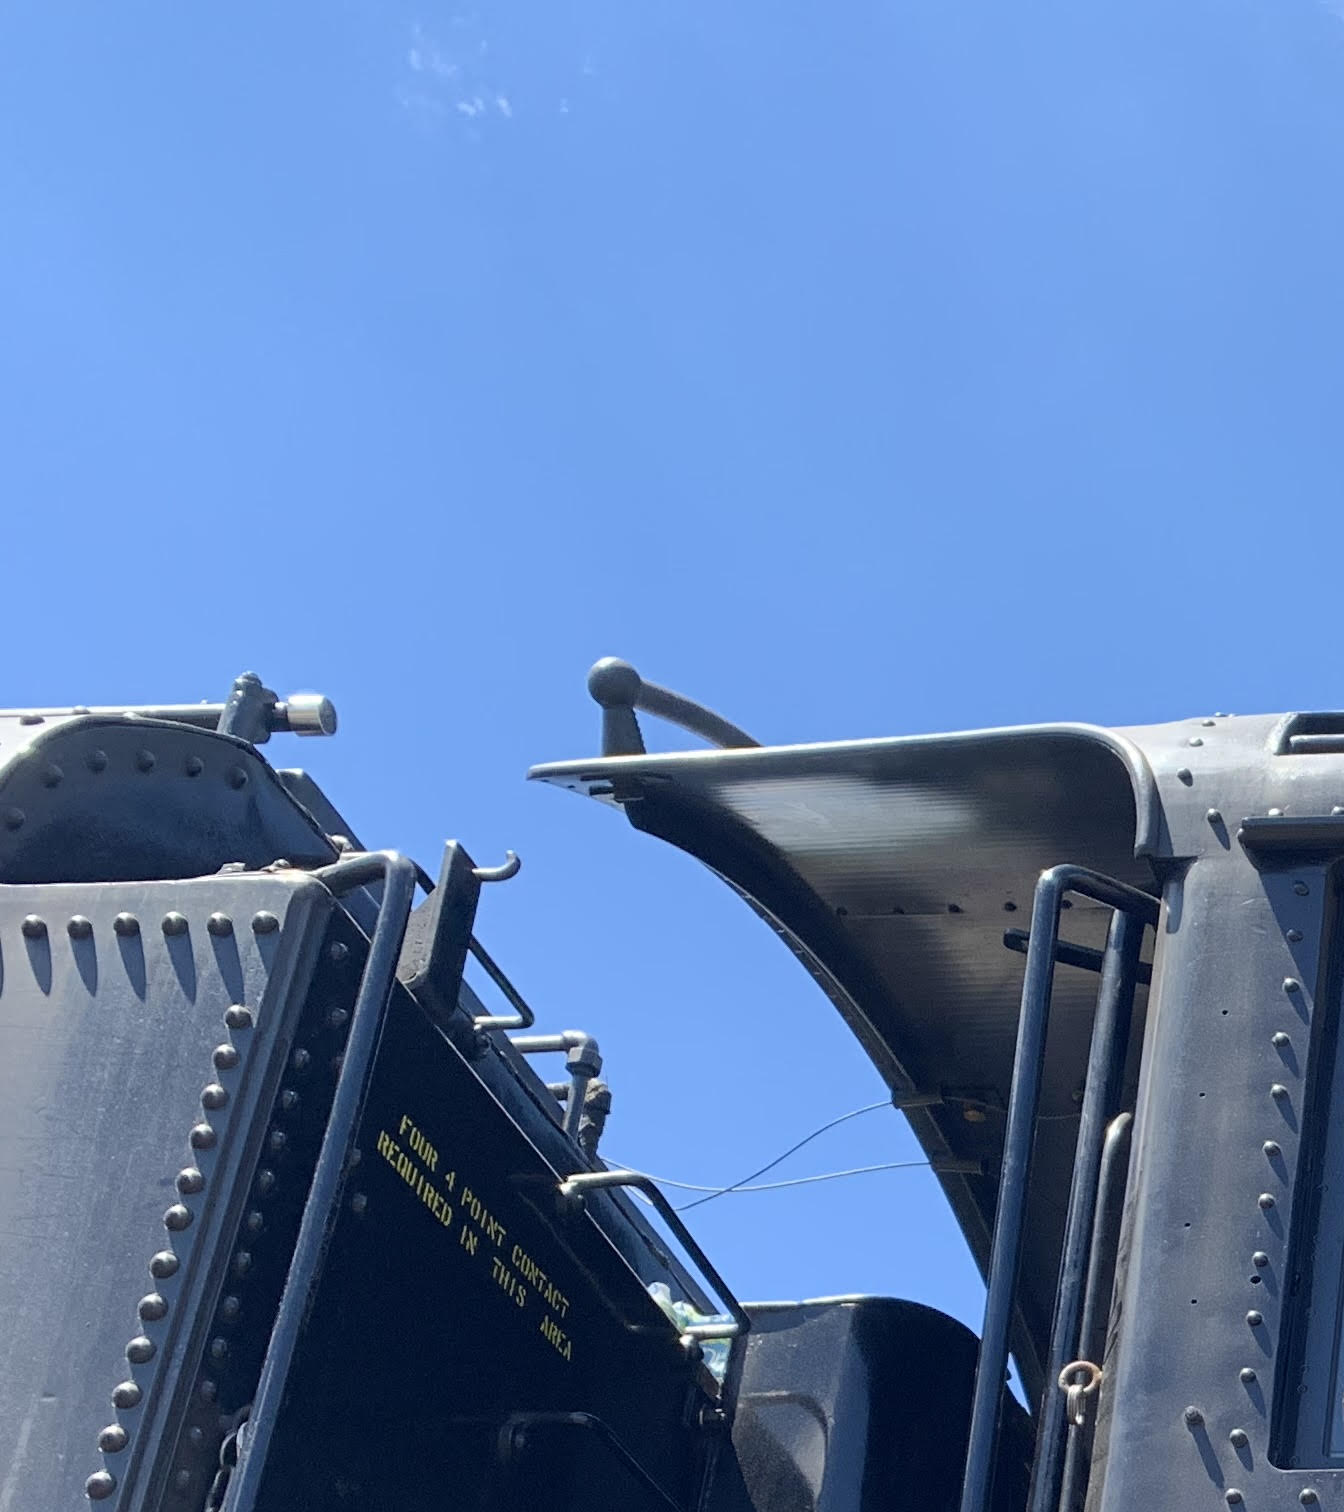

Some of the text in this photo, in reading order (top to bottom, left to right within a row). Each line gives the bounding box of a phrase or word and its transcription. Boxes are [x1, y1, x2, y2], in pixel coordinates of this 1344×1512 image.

[376, 1130, 574, 1361] REQUIRED IN THIS AREA
[399, 1114, 571, 1318] FOUR 4 POINT CONTACT
